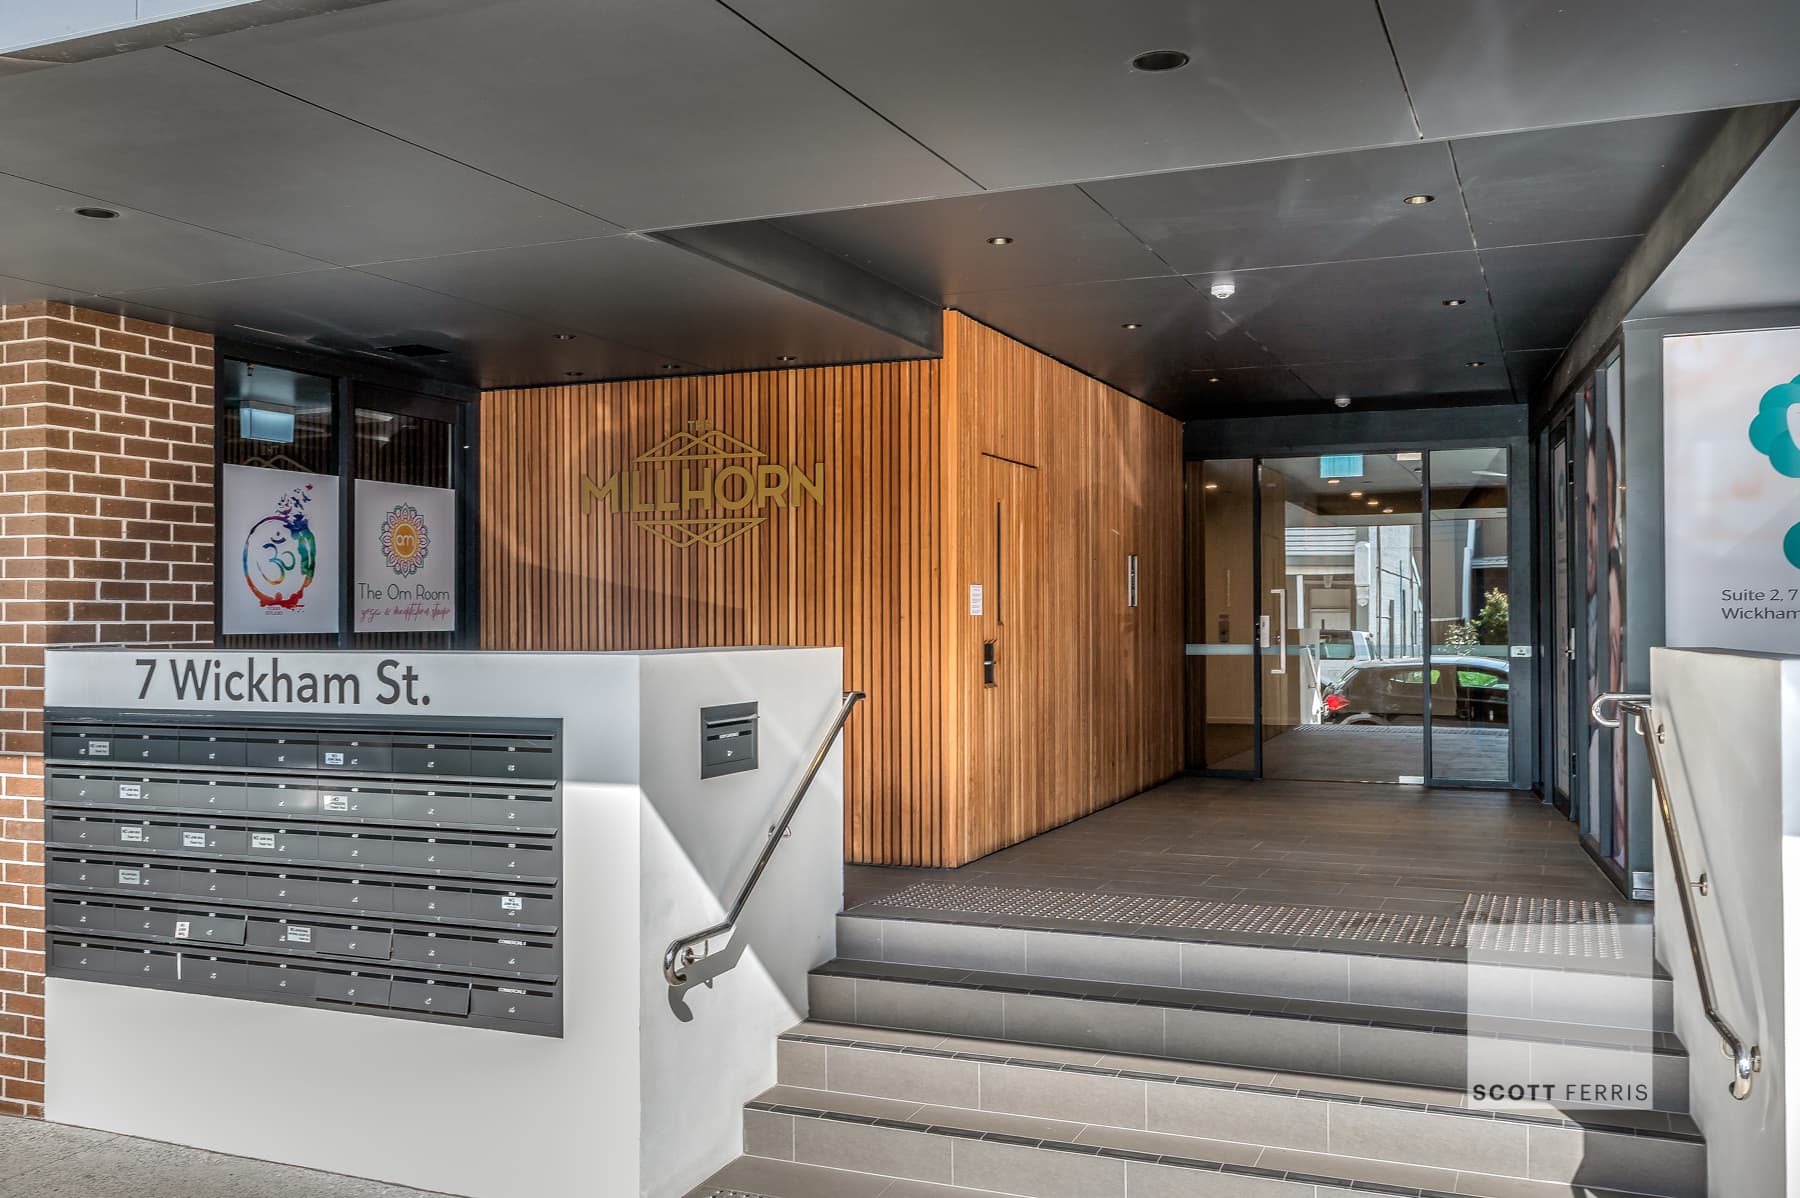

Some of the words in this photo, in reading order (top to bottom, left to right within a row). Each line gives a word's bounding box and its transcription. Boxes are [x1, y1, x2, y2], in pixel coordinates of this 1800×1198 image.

[581, 463, 824, 515] MILLHORN
[357, 583, 382, 600] The
[387, 583, 412, 600] Om
[416, 584, 450, 600] Room
[1722, 589, 1765, 601] Suite
[1770, 589, 1784, 602] 2,
[1788, 589, 1798, 601] 7
[136, 659, 157, 700] 7
[169, 657, 360, 705] Wickham
[376, 659, 430, 706] St.
